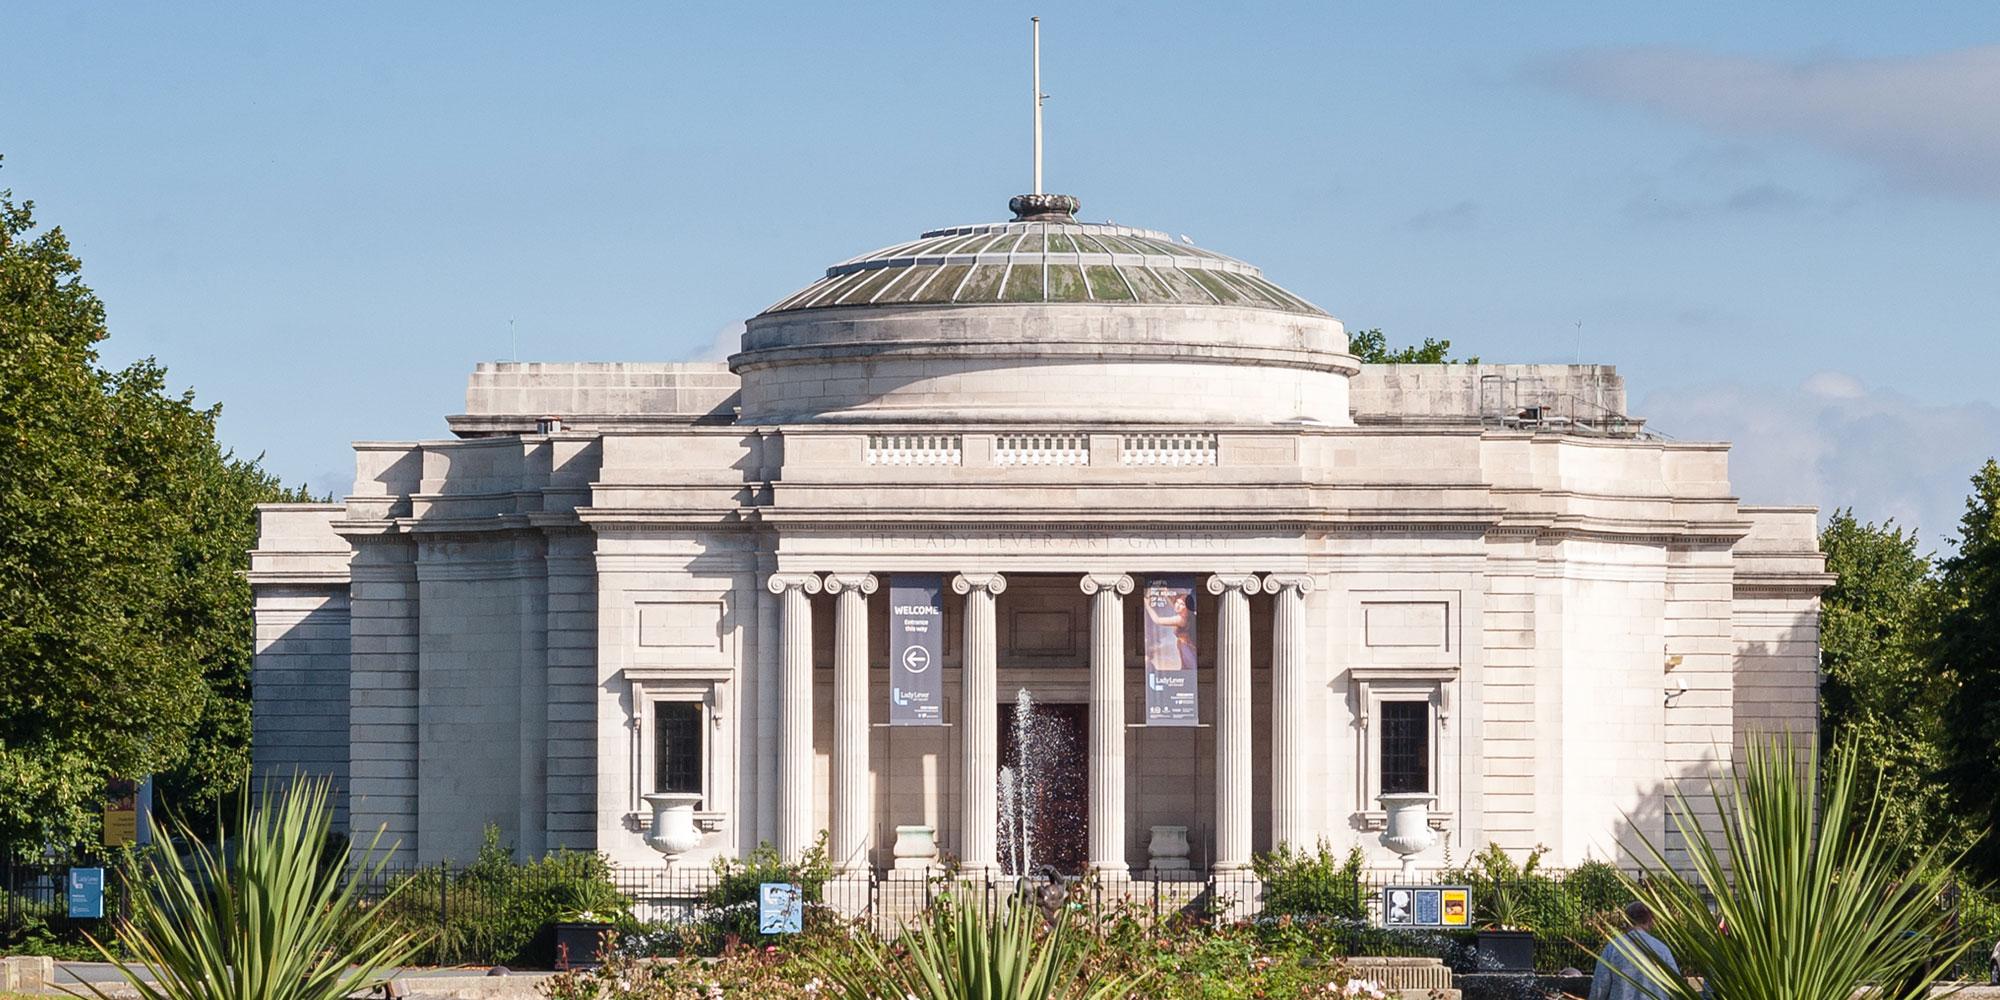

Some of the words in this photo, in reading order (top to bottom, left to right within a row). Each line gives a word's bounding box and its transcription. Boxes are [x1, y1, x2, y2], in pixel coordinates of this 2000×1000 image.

[858, 533, 898, 549] THE
[912, 533, 971, 549] LADY
[986, 533, 1053, 549] LEVER
[1068, 533, 1112, 549] ART
[1127, 533, 1231, 549] GALLERY
[894, 605, 939, 615] WELCOME
[1155, 677, 1169, 685] Lady
[900, 691, 914, 699] Lady
